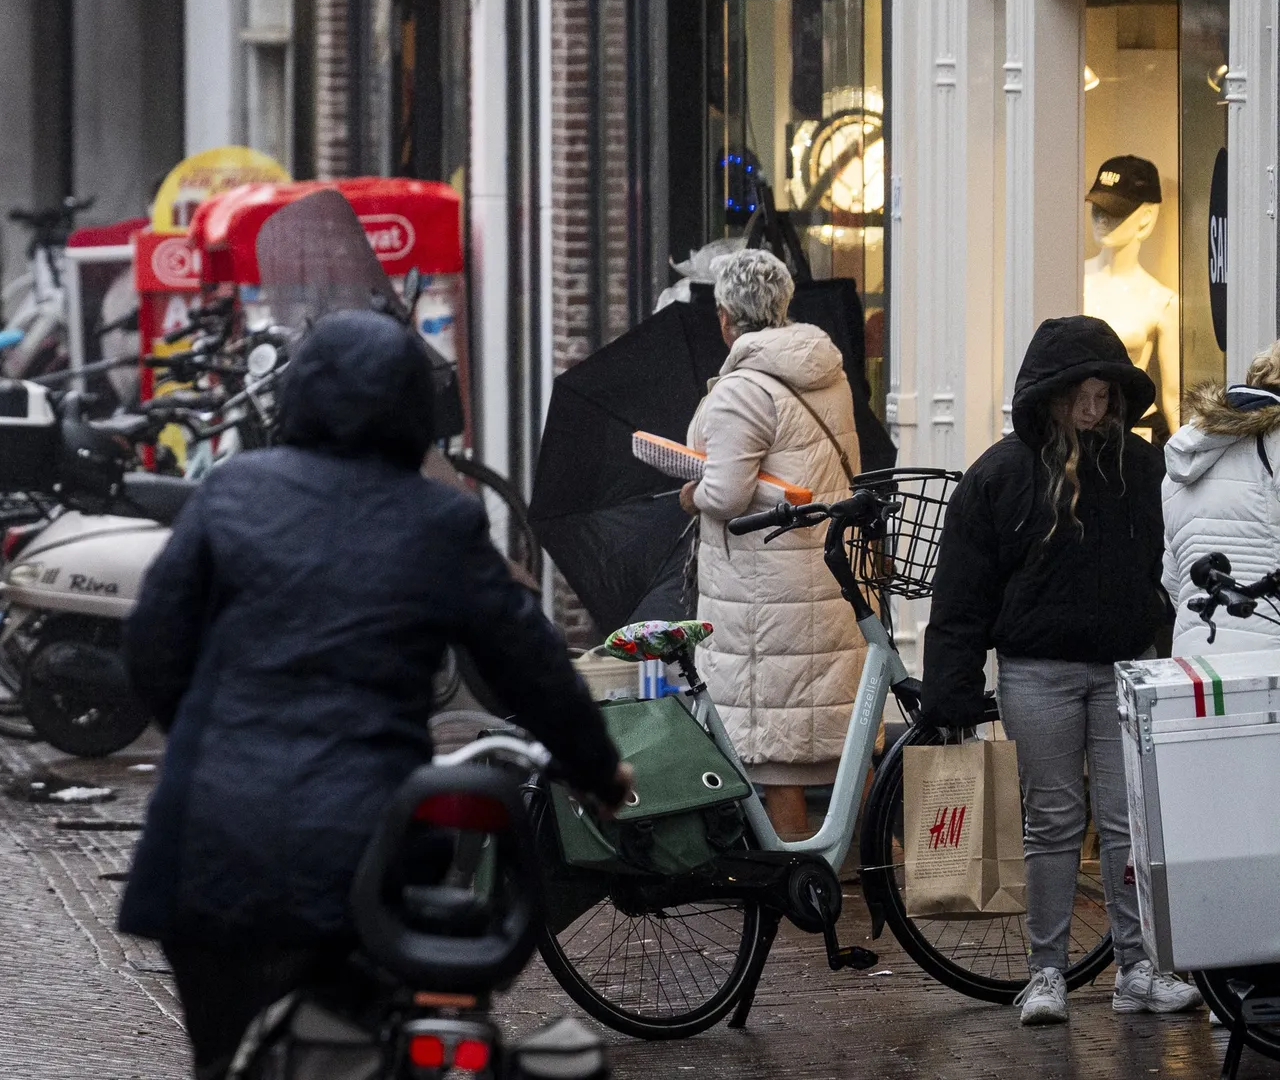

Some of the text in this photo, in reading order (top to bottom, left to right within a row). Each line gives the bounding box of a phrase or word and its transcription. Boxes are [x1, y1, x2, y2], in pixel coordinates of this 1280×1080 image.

[69, 573, 119, 594] Riva
[860, 677, 878, 726] Gazelle
[929, 805, 967, 850] H&M
